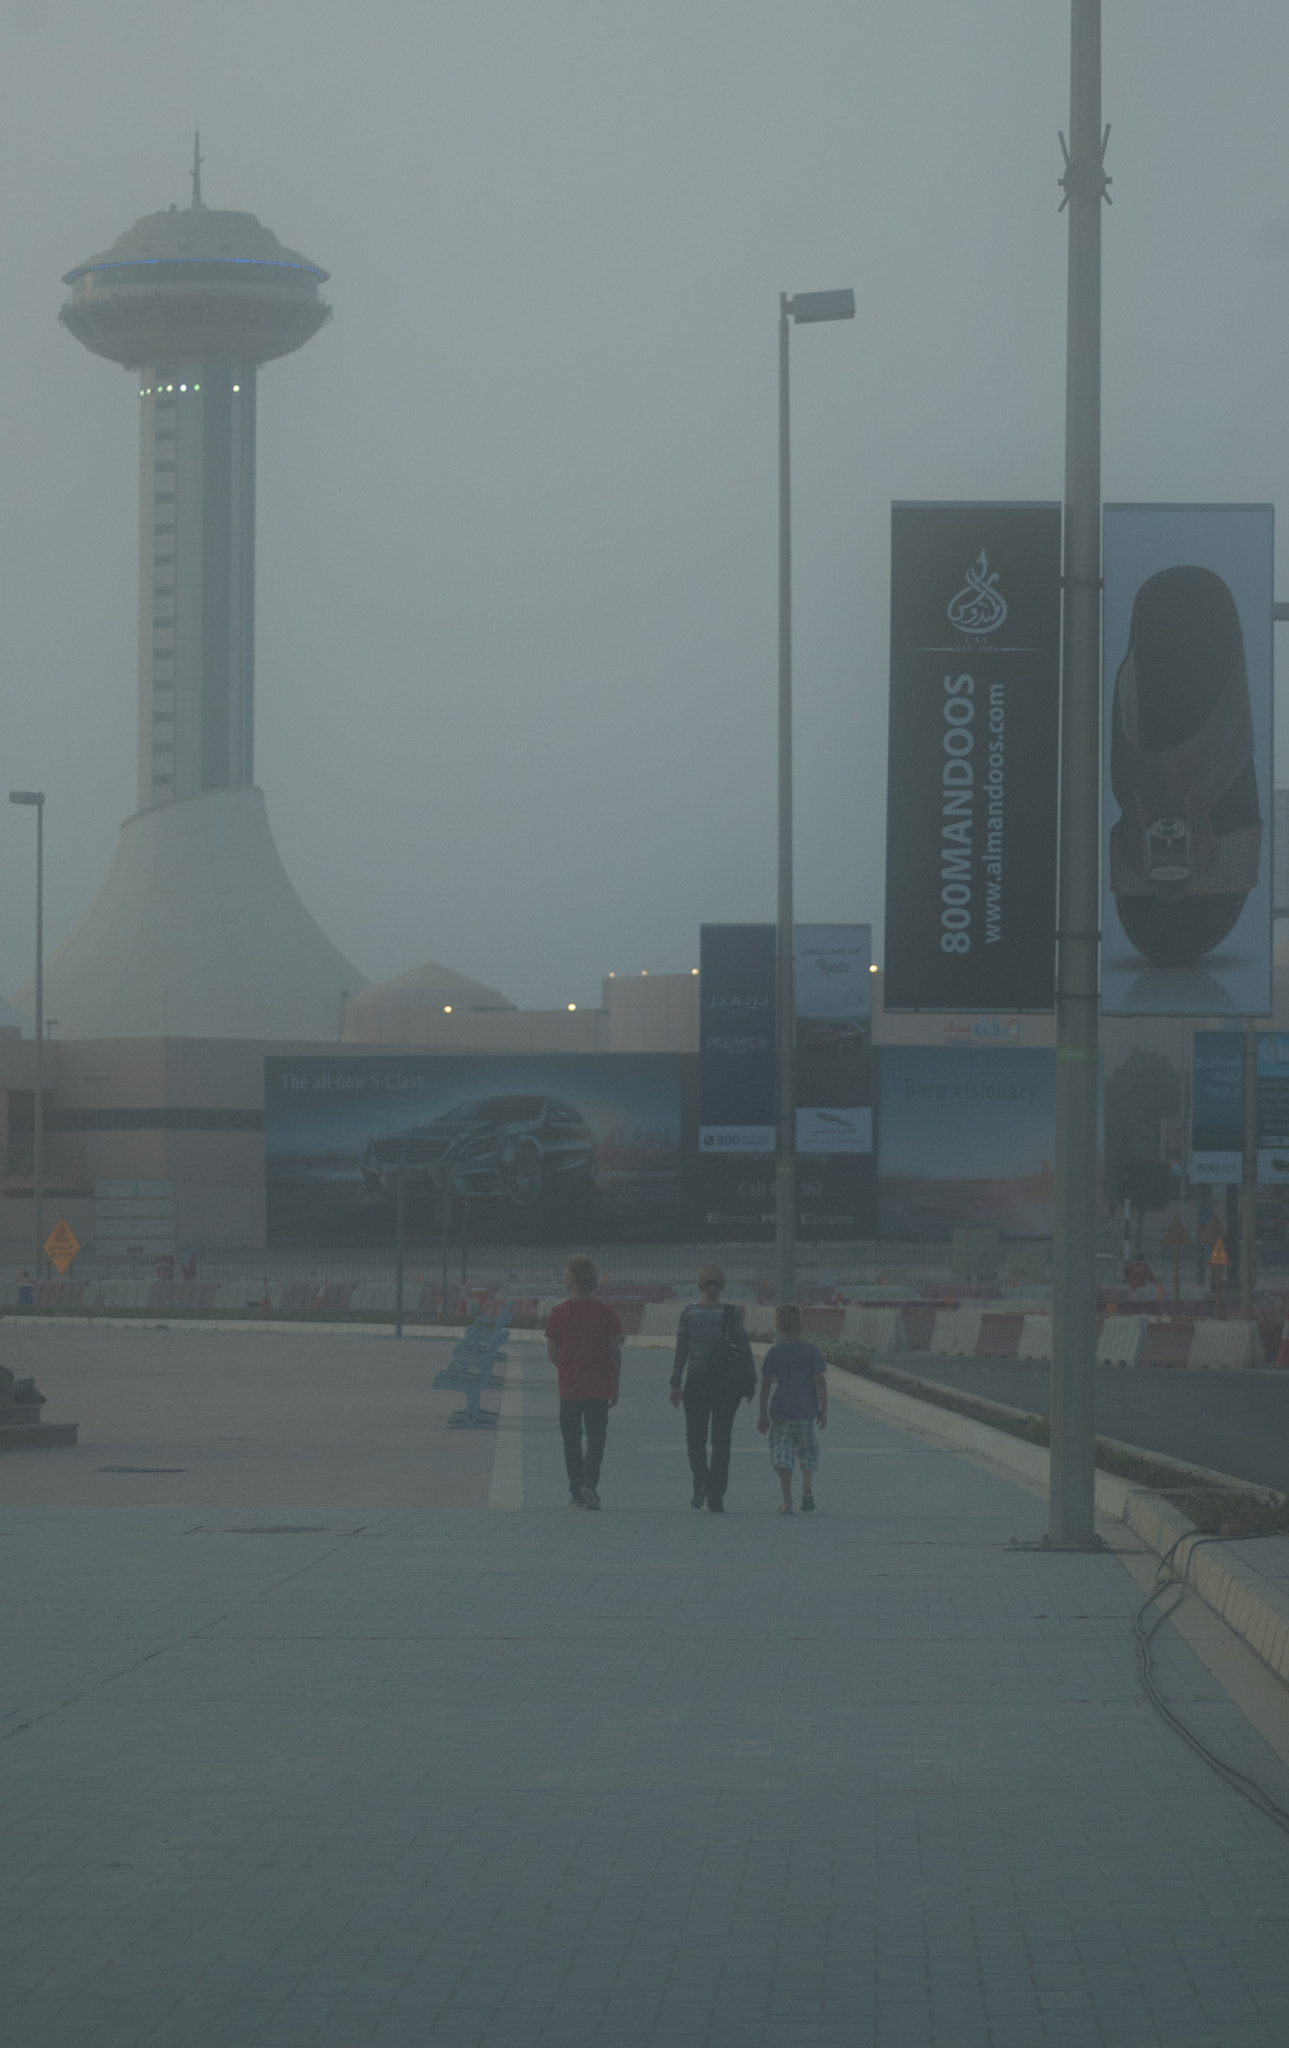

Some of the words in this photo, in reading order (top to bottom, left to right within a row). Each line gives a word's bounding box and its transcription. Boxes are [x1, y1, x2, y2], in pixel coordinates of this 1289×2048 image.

[941, 673, 976, 954] 800MANDOOS
[980, 682, 1004, 944] www.almandoos.com
[706, 1036, 769, 1049] PREMIER
[281, 1072, 309, 1090] The
[313, 1072, 366, 1090] all-new
[904, 1078, 946, 1099] Born
[716, 1134, 740, 1146] 800
[739, 1181, 766, 1198] Call
